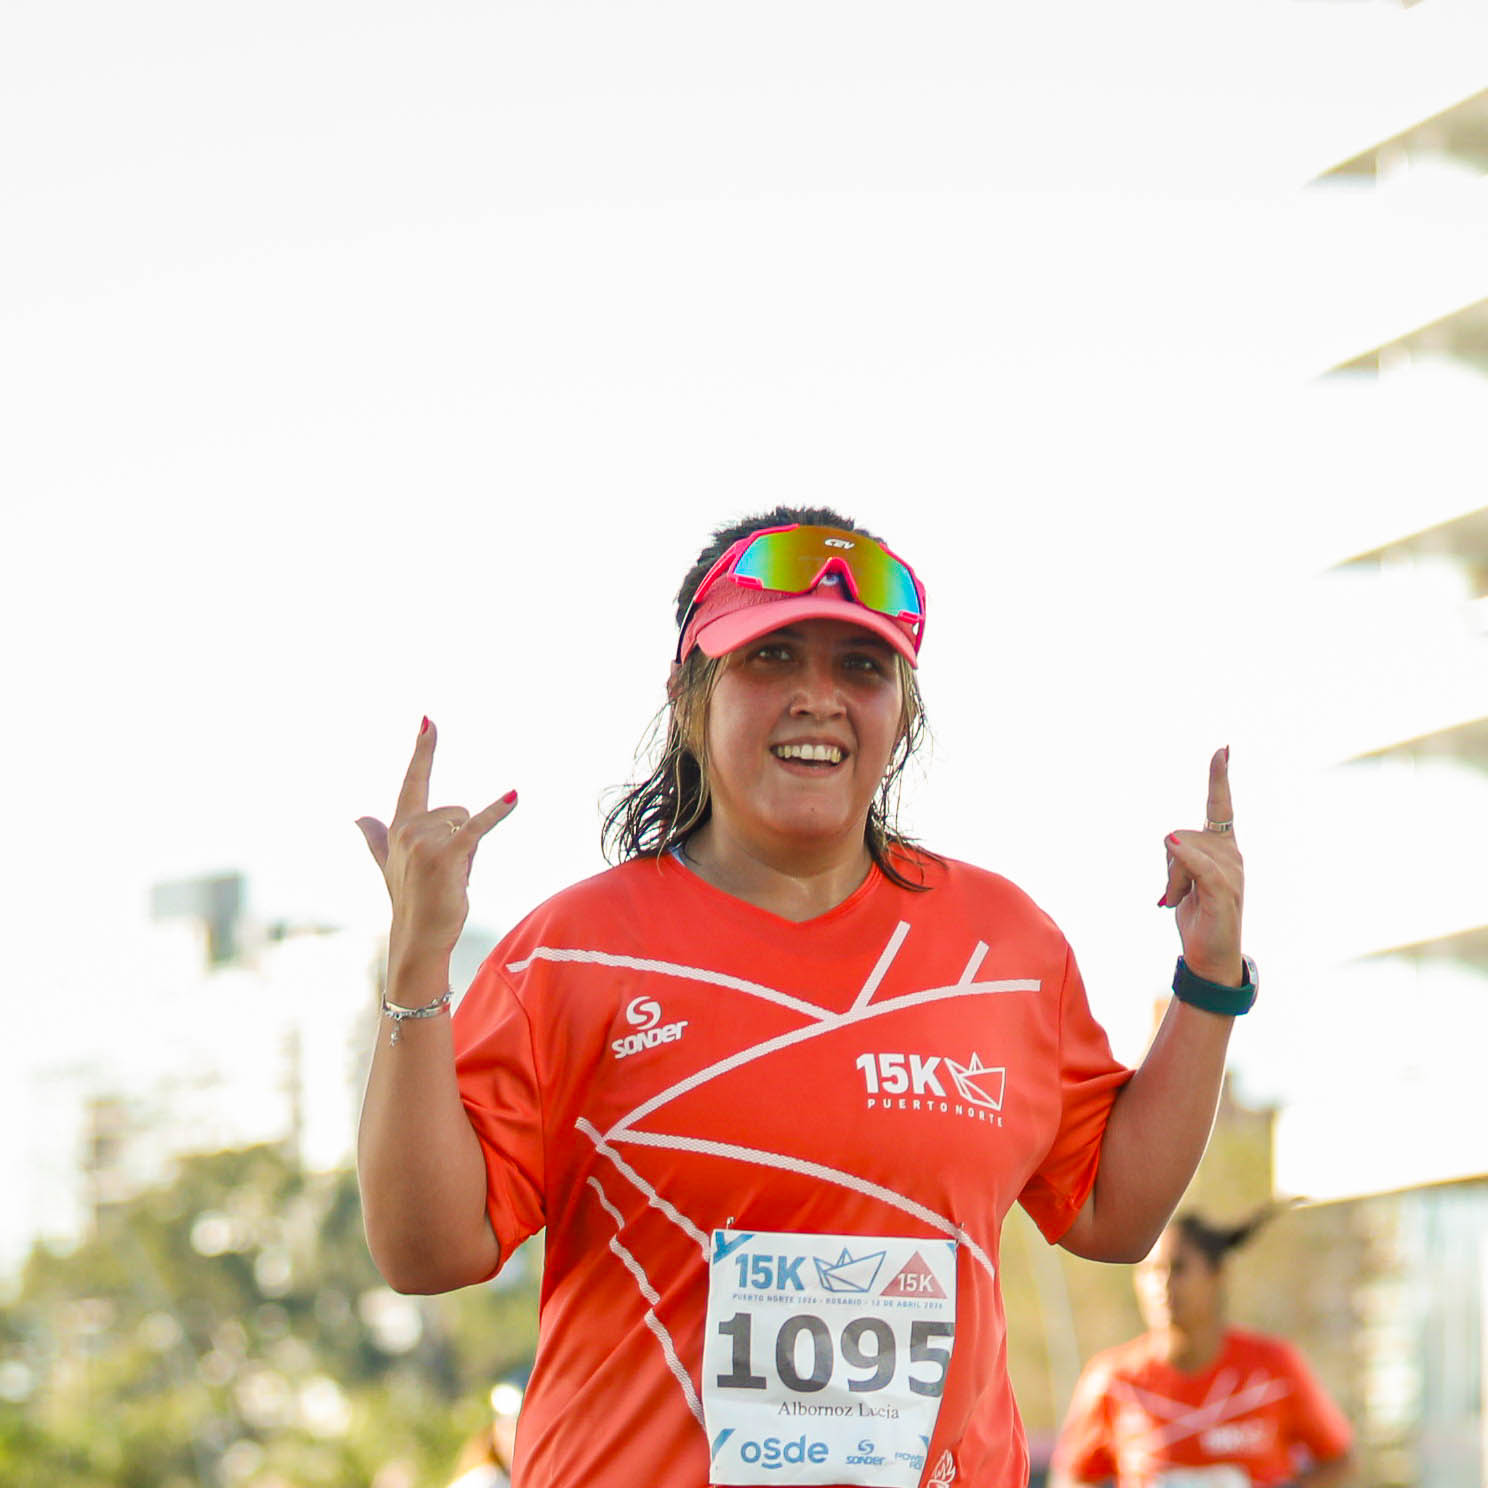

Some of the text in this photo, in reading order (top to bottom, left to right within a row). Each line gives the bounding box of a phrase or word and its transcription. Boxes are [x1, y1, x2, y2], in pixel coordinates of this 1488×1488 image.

[855, 1052, 947, 1097] 15K
[734, 1253, 808, 1292] 15K
[897, 1272, 935, 1293] 15K
[716, 1312, 956, 1398] 1095
[778, 1401, 854, 1417] Albornoz
[740, 1433, 830, 1469] osde
